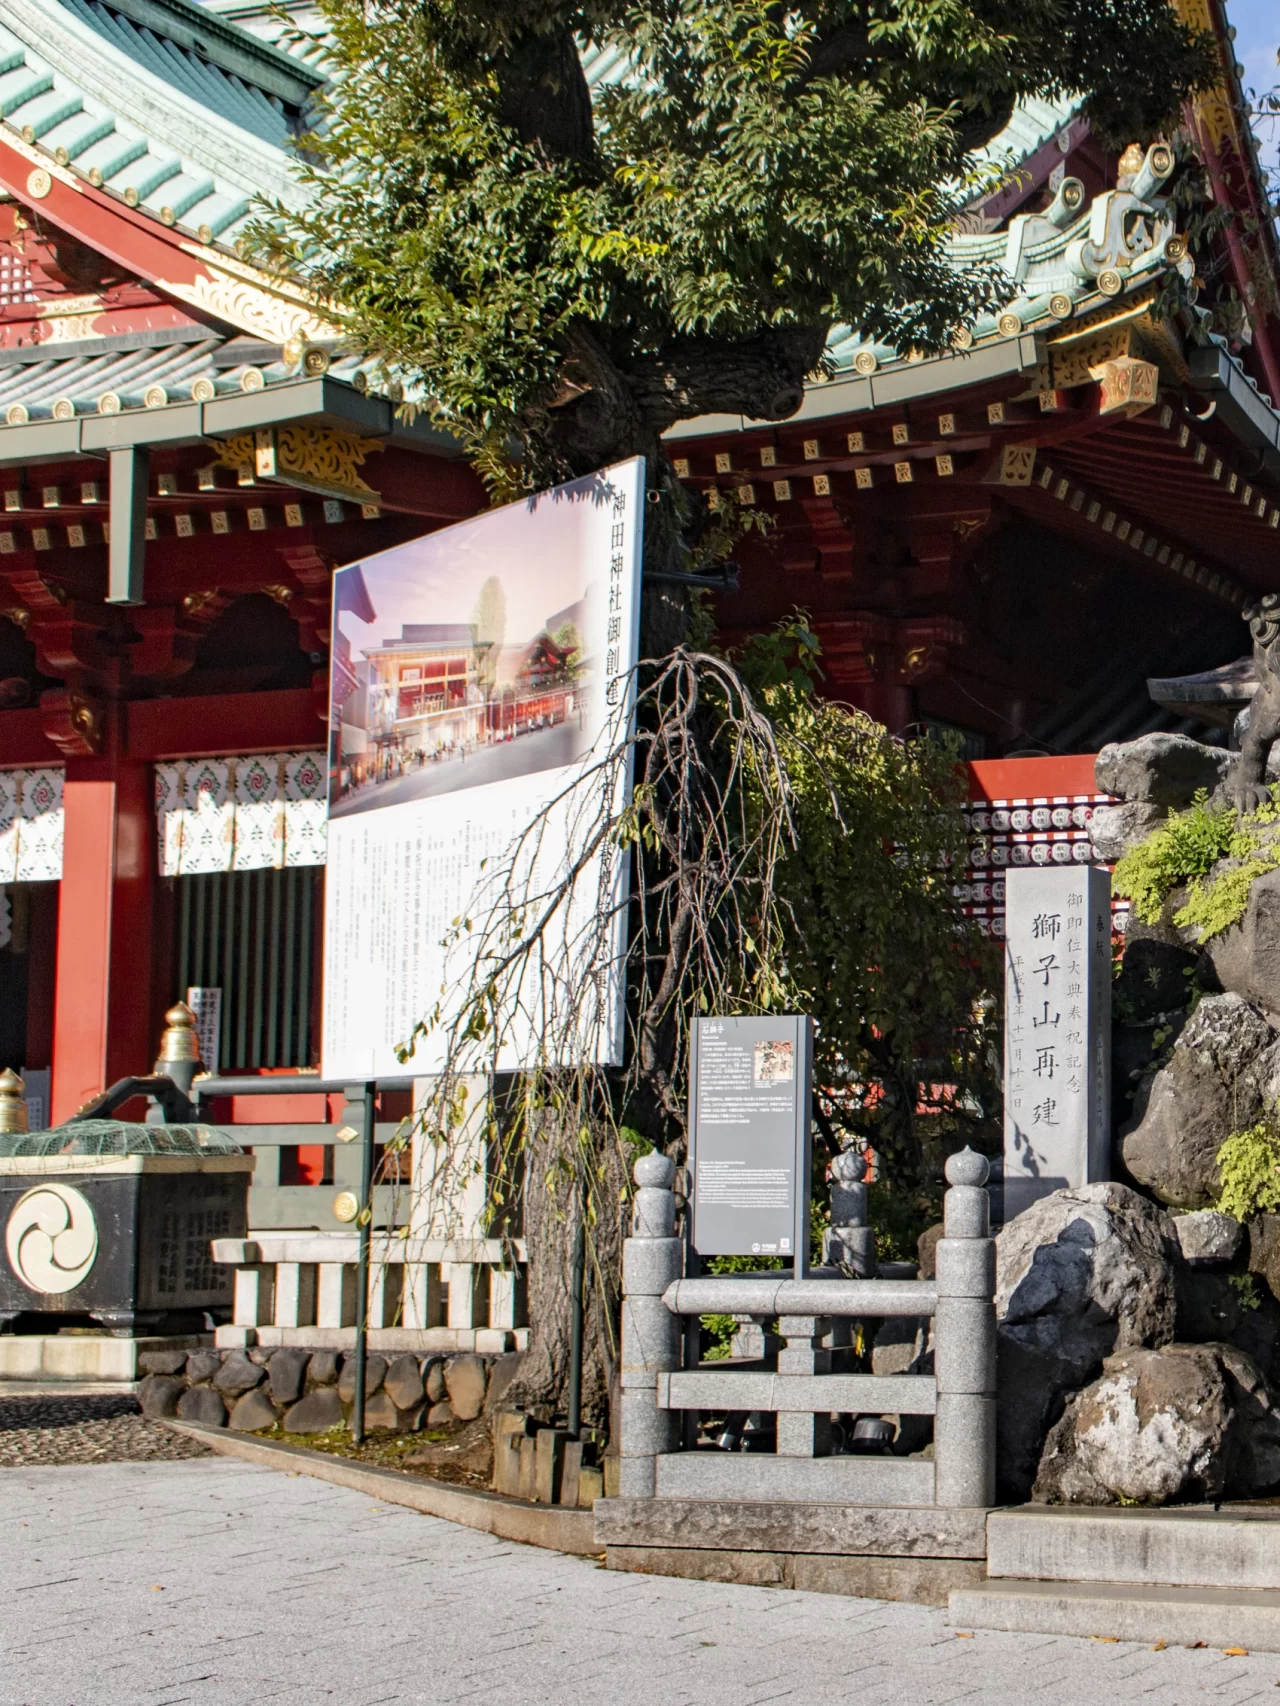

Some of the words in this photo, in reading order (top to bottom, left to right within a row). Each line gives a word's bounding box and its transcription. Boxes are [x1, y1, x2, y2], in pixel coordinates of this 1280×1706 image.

[1032, 913, 1062, 1127] 獅子山再建
[1066, 893, 1084, 1094] 御即位大典奉祝記念
